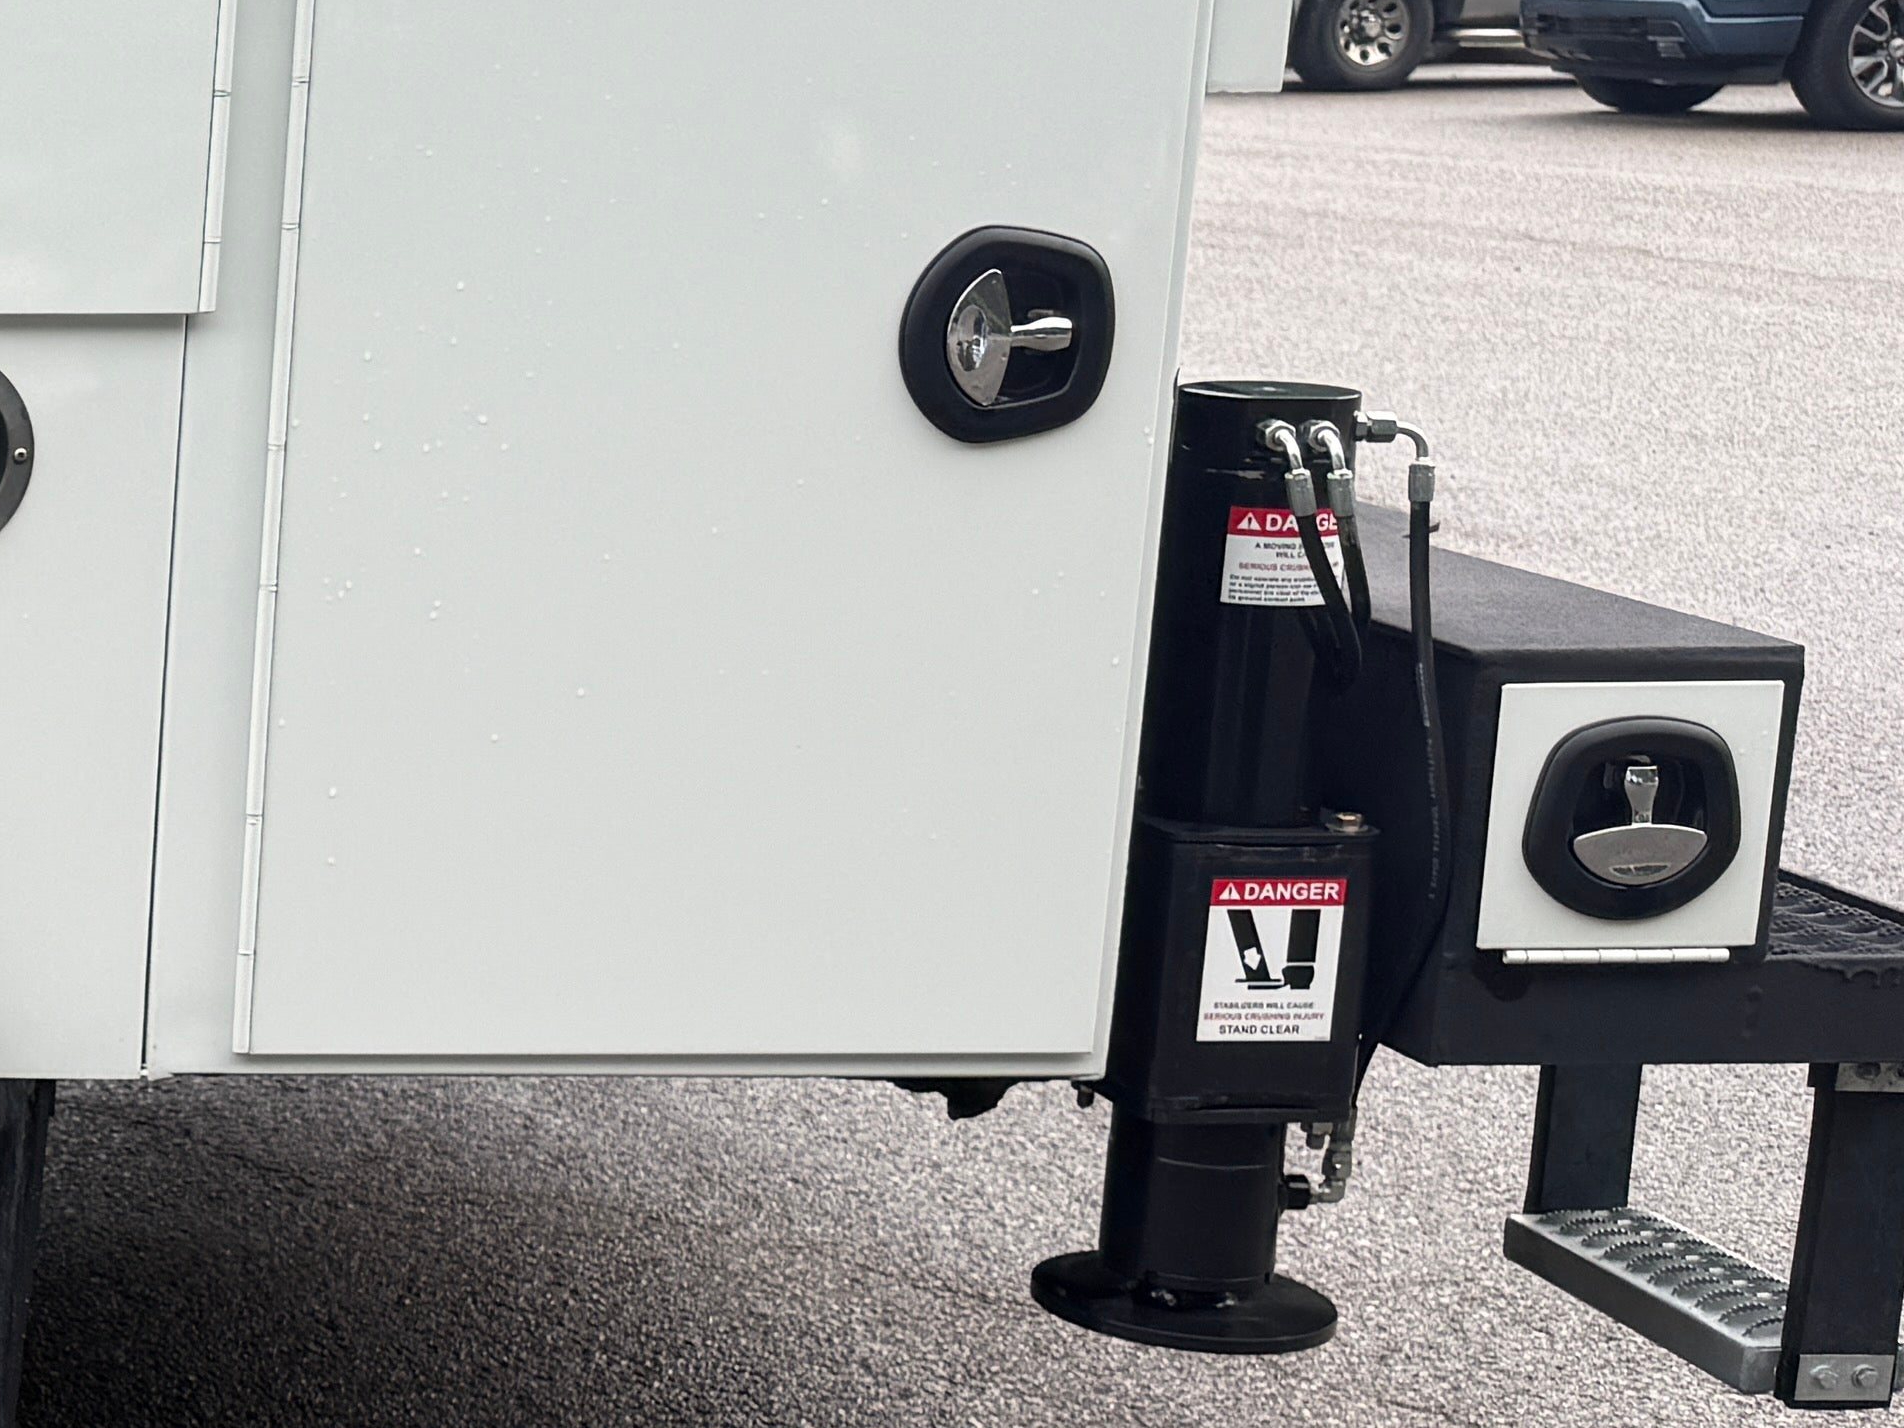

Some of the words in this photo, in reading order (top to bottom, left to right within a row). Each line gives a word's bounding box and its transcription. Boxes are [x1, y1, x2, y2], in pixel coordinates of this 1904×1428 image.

[1265, 513, 1338, 532] DAGE
[1280, 562, 1311, 571] CRUSH
[1243, 883, 1340, 900] DANGER
[1219, 1025, 1257, 1034] STAND
[1260, 1025, 1300, 1034] CLEAR
